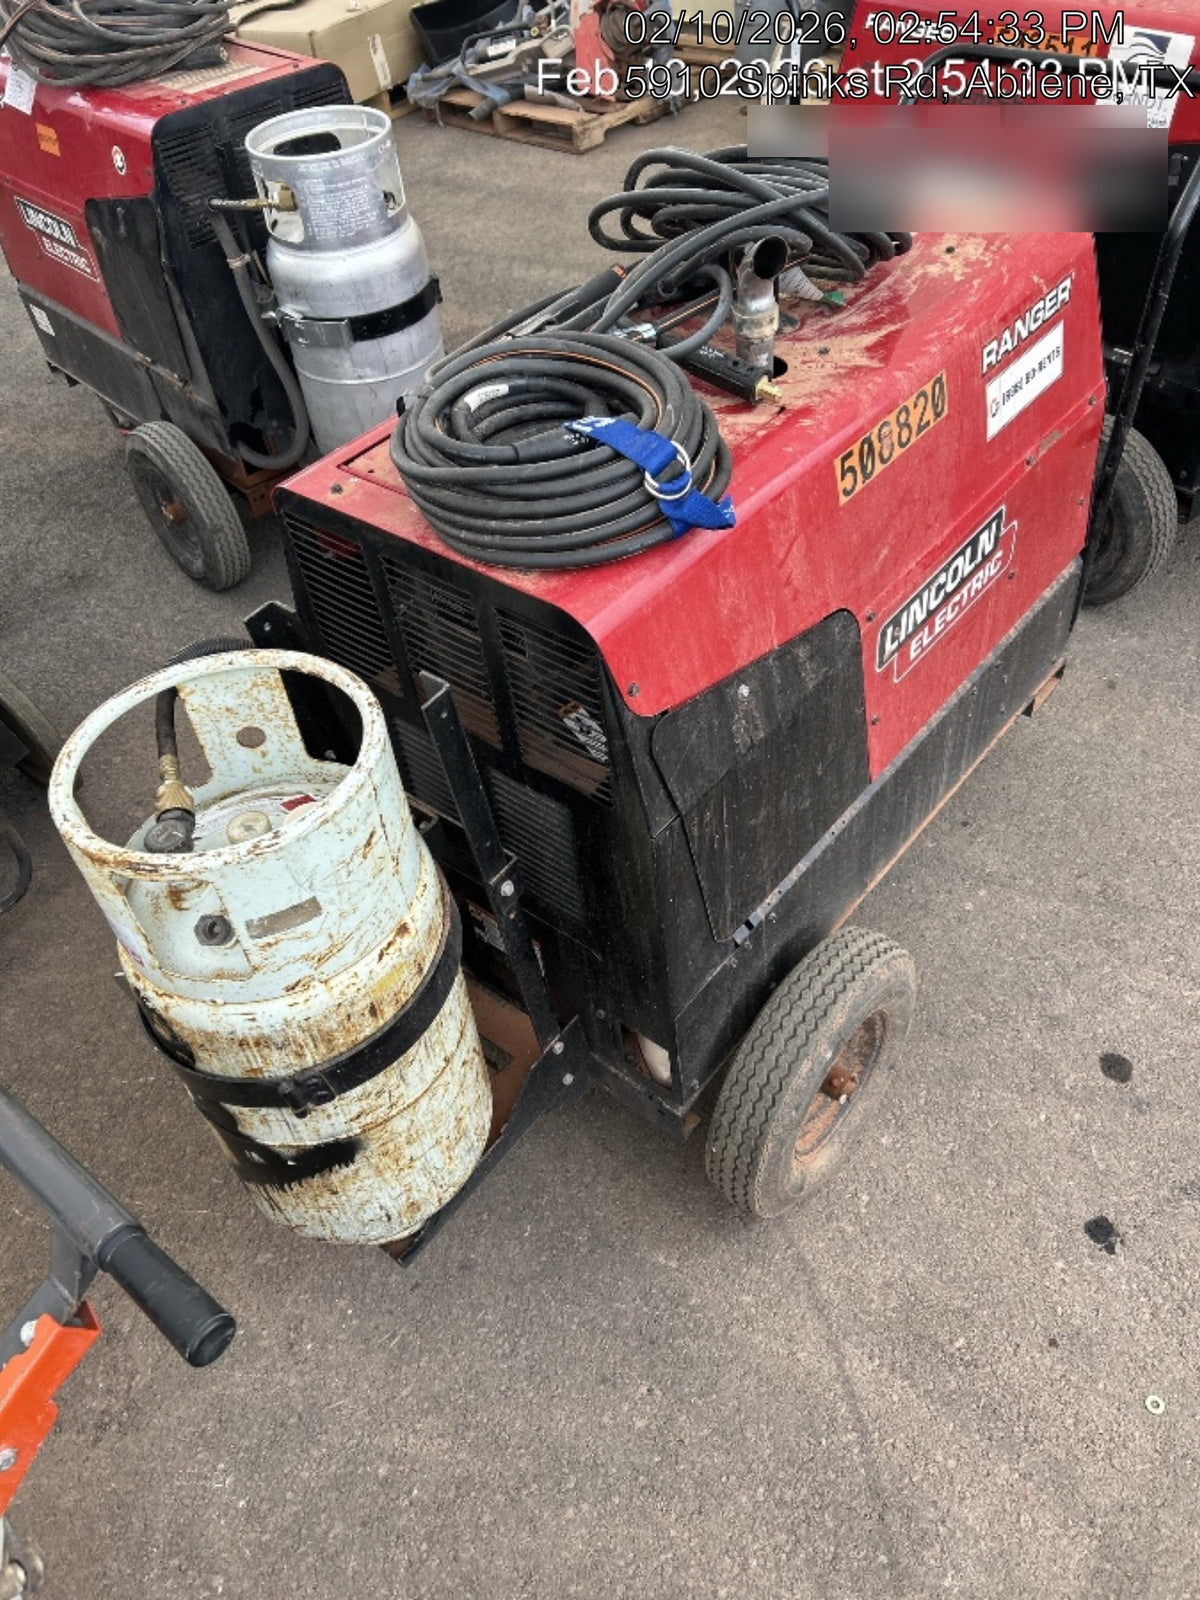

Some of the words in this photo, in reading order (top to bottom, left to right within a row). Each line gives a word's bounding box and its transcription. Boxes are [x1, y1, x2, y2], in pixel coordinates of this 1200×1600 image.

[981, 274, 1073, 378] RANGER
[839, 373, 946, 497] 508820
[882, 518, 1000, 662] LINCOLN
[909, 549, 1004, 662] ELECTRIC
